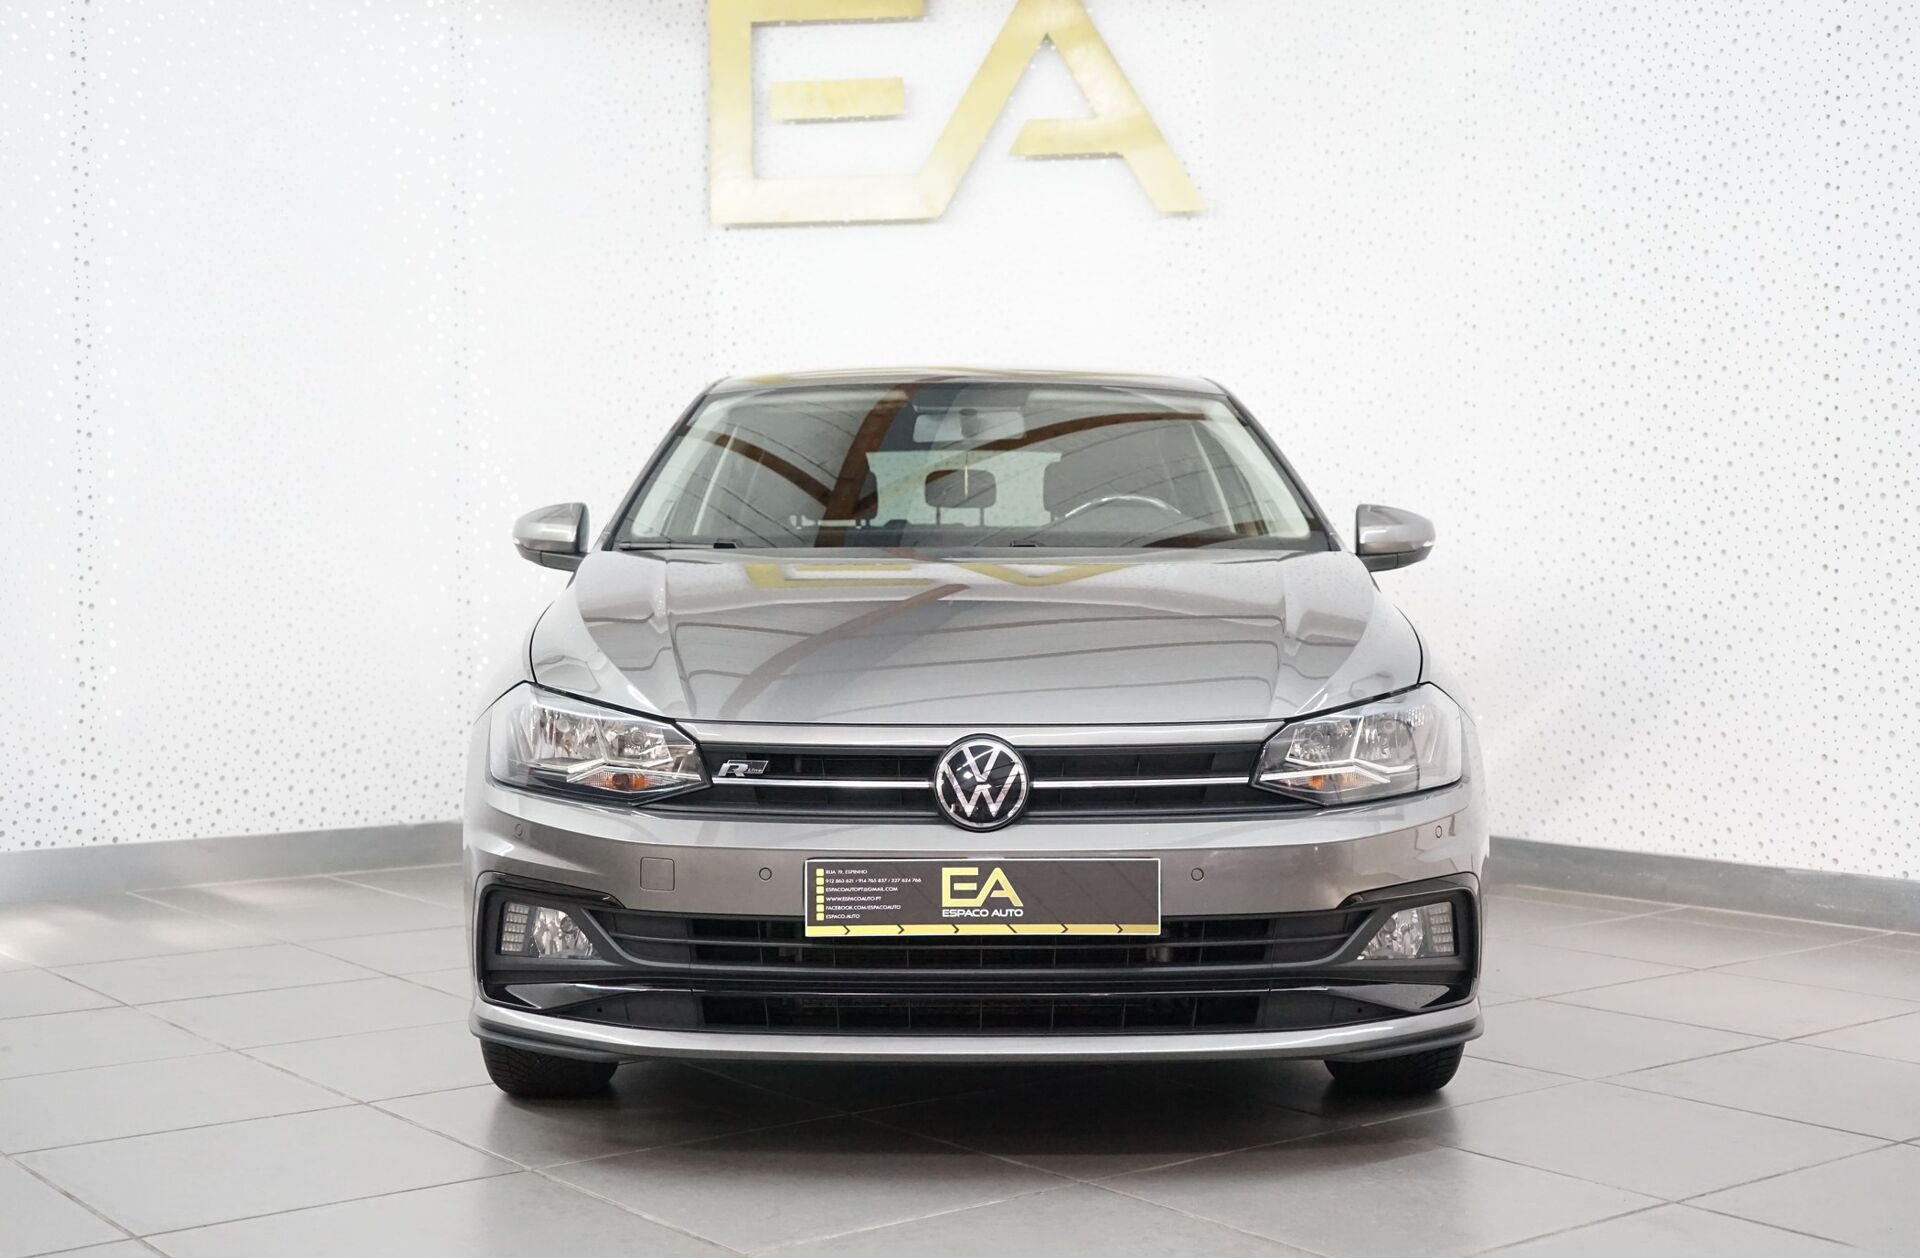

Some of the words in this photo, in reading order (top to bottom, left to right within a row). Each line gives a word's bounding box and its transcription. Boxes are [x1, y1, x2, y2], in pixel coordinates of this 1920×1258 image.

[709, 0, 1208, 224] EA
[717, 762, 749, 777] R
[941, 867, 1024, 907] EA
[942, 909, 989, 917] ESPACO
[991, 909, 1024, 917] AUTO
